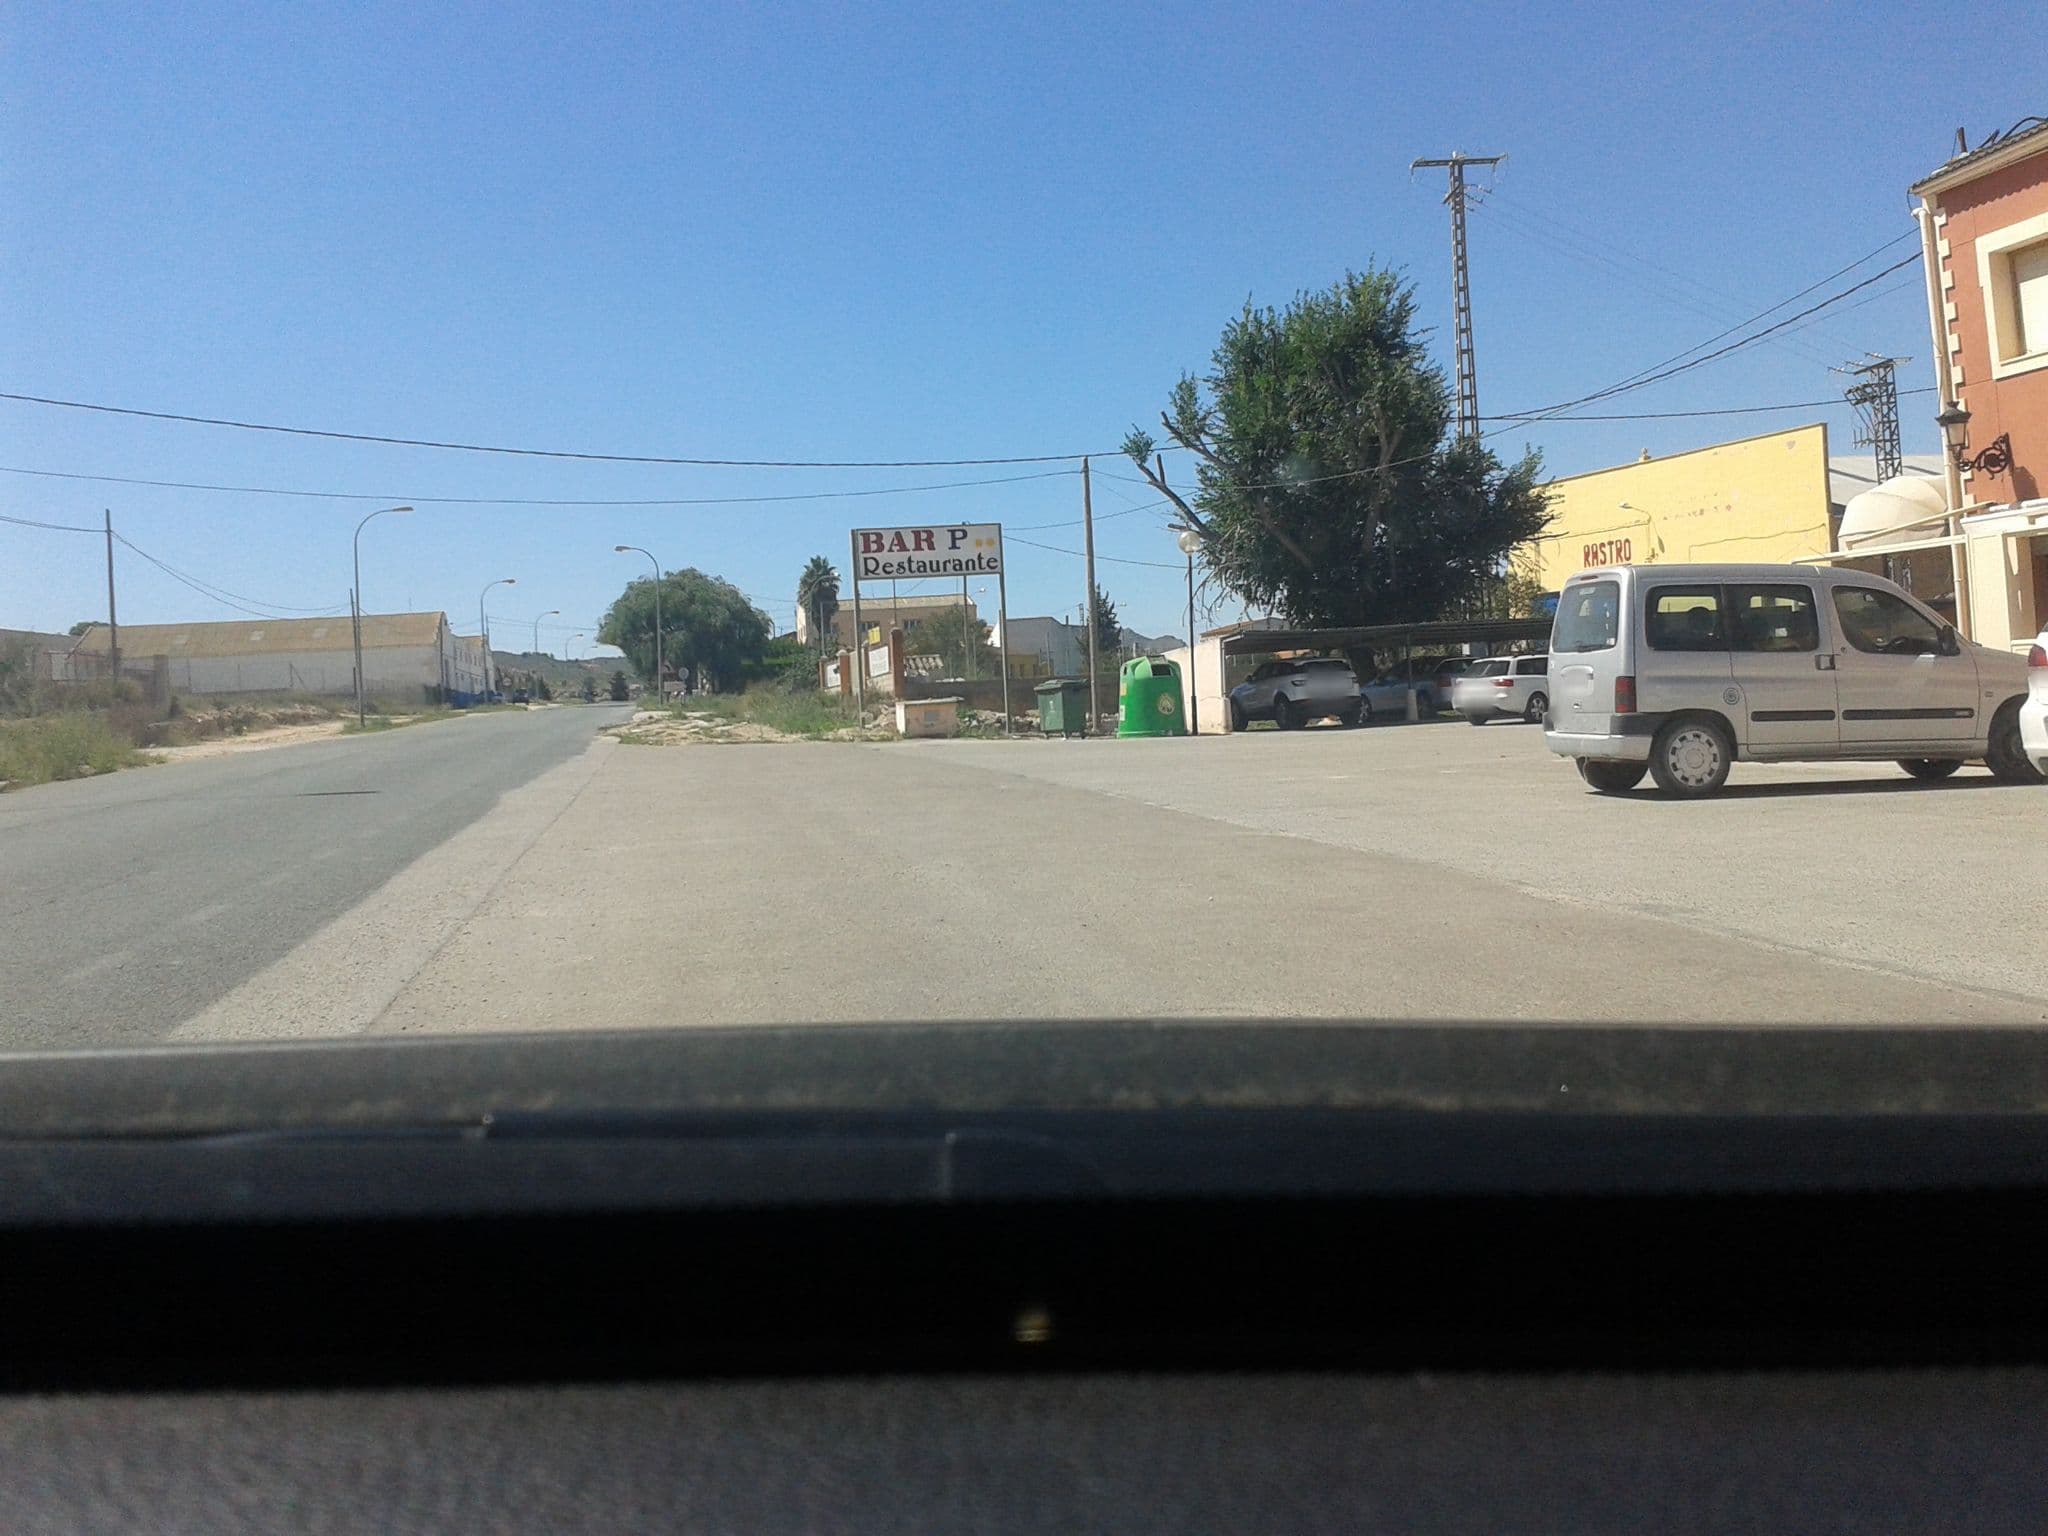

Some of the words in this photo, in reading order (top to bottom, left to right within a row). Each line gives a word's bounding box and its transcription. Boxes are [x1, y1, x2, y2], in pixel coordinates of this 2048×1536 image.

[860, 529, 936, 554] BAR
[947, 529, 968, 550] P
[1583, 538, 1632, 568] RASTRO
[863, 551, 999, 576] Restaurante
